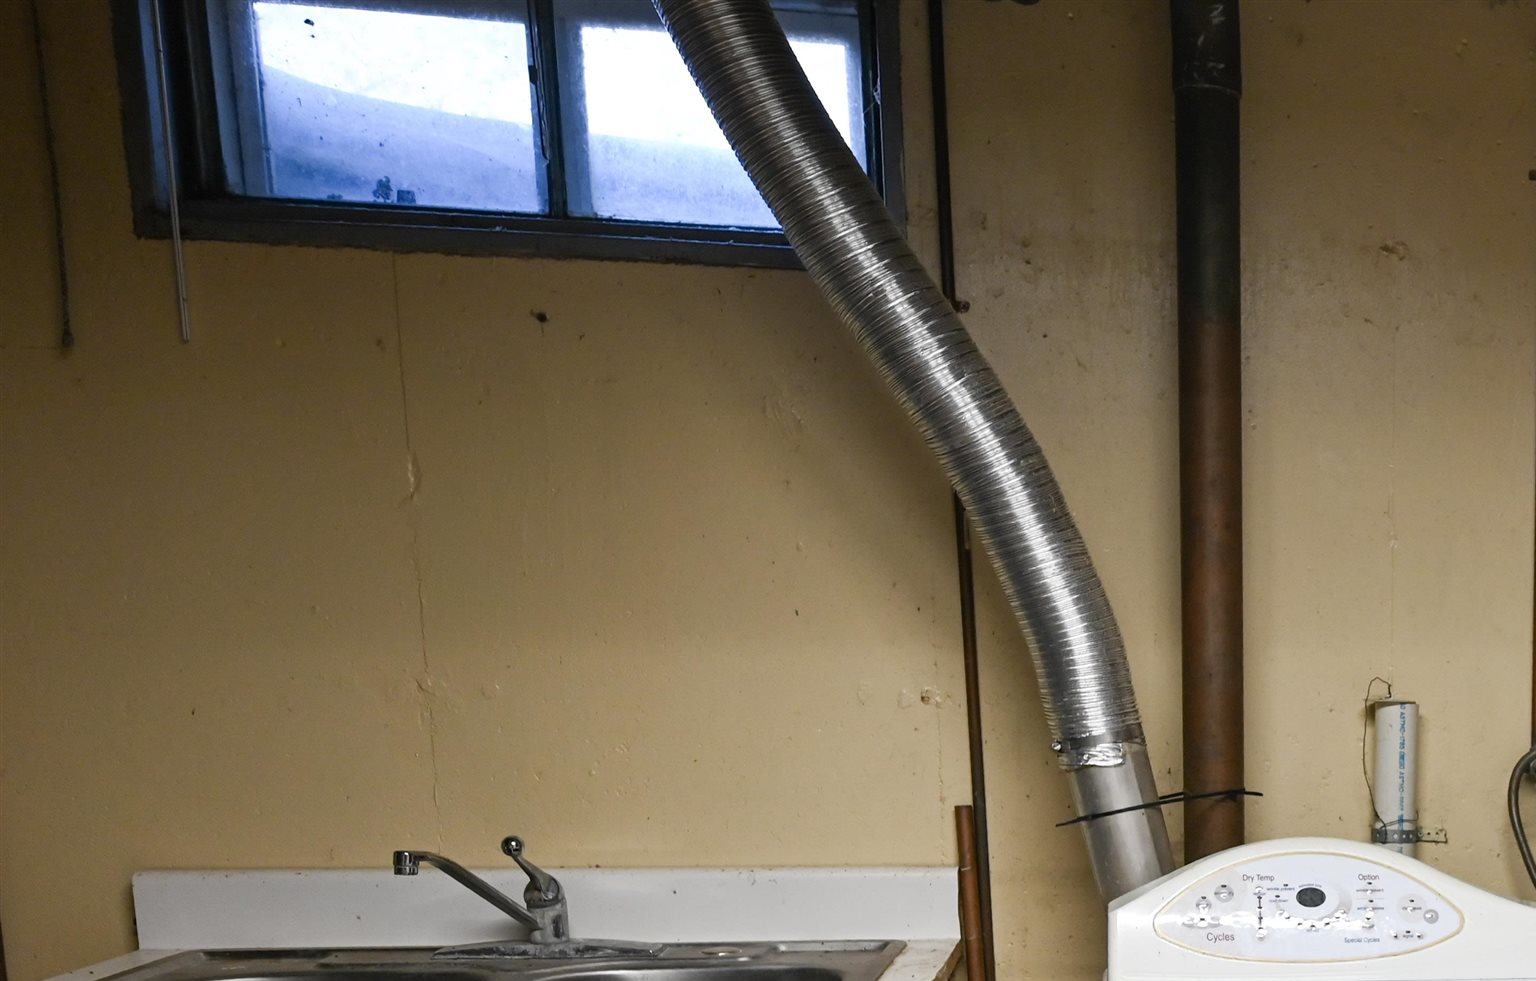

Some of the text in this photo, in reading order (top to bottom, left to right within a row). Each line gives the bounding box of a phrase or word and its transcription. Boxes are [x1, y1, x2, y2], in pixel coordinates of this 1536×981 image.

[1242, 874, 1275, 883] Dry Temp
[1357, 873, 1380, 882] Option
[1206, 932, 1235, 943] Cycles
[1344, 936, 1380, 944] Special Cycles
